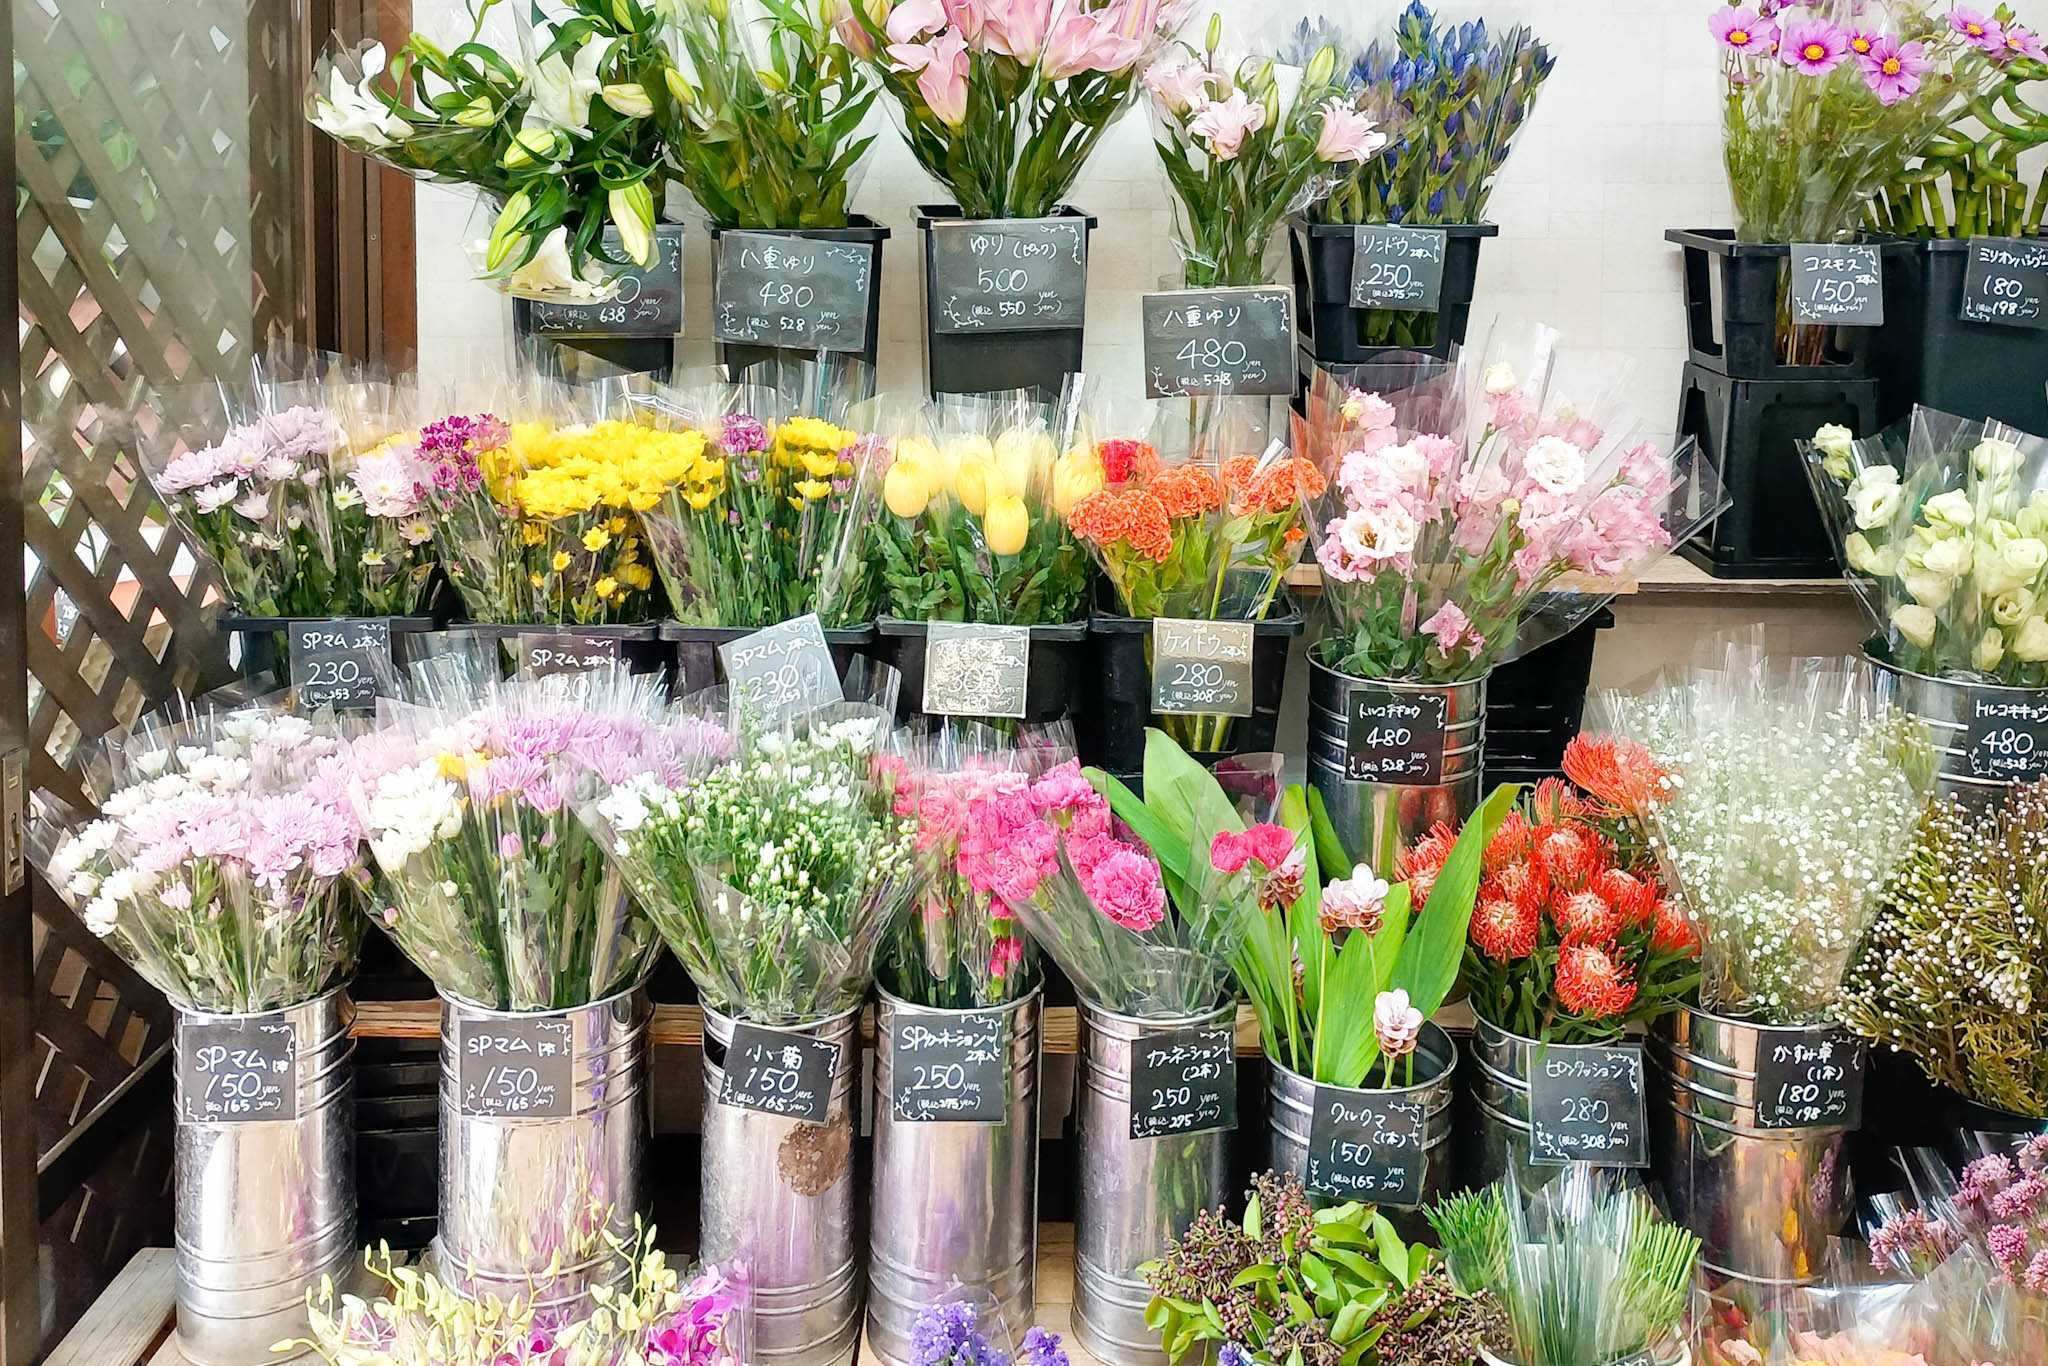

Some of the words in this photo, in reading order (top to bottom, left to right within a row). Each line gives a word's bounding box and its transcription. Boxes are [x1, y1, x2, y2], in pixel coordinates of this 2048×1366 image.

[970, 234, 1003, 255] ゆり
[1363, 235, 1408, 256] リンドウ
[740, 246, 815, 274] 八重ゆり
[1803, 257, 1861, 272] コスモス
[978, 268, 1028, 293] 500
[1366, 263, 1412, 288] 250
[1984, 275, 2022, 298] 180
[759, 281, 814, 308] 480
[1812, 278, 1855, 302] 150
[600, 306, 626, 323] 638
[999, 301, 1026, 316] 550
[1163, 305, 1241, 328] 八重ゆり
[1993, 301, 2017, 315] 198
[780, 316, 805, 331] 528
[1176, 338, 1247, 369] 480
[1203, 371, 1231, 385] 528
[302, 632, 348, 649] SPマム
[531, 649, 580, 667] SPマム
[732, 641, 785, 669] SPマム
[306, 661, 359, 685] 230
[747, 665, 799, 702] 230
[1171, 663, 1223, 686] 280
[329, 689, 349, 699] 253
[1193, 689, 1214, 703] 308
[1367, 727, 1411, 748] 480
[1981, 728, 2033, 754] 480
[1382, 758, 1405, 772] 528
[2006, 758, 2027, 770] 528
[468, 1035, 532, 1056] SPマム
[1773, 1040, 1833, 1064] かすみ草
[196, 1046, 267, 1072] SPマム
[746, 1044, 803, 1070] 小菊
[1147, 1046, 1225, 1068] カーネーション
[480, 1066, 537, 1097] 150
[745, 1067, 799, 1093] 150
[912, 1063, 964, 1089] 250
[1182, 1062, 1220, 1081] (2本)
[205, 1072, 262, 1099] 150
[1779, 1083, 1819, 1105] 180
[224, 1100, 250, 1114] 165
[506, 1097, 529, 1111] 165
[757, 1095, 788, 1111] 165
[1151, 1087, 1190, 1110] 250
[1169, 1114, 1194, 1128] 275
[1331, 1103, 1386, 1129] クルクマ
[1561, 1097, 1609, 1123] 280
[1796, 1106, 1821, 1121] 198
[1331, 1139, 1372, 1166] 150
[1581, 1134, 1606, 1149] 308
[1352, 1175, 1376, 1189] 165
